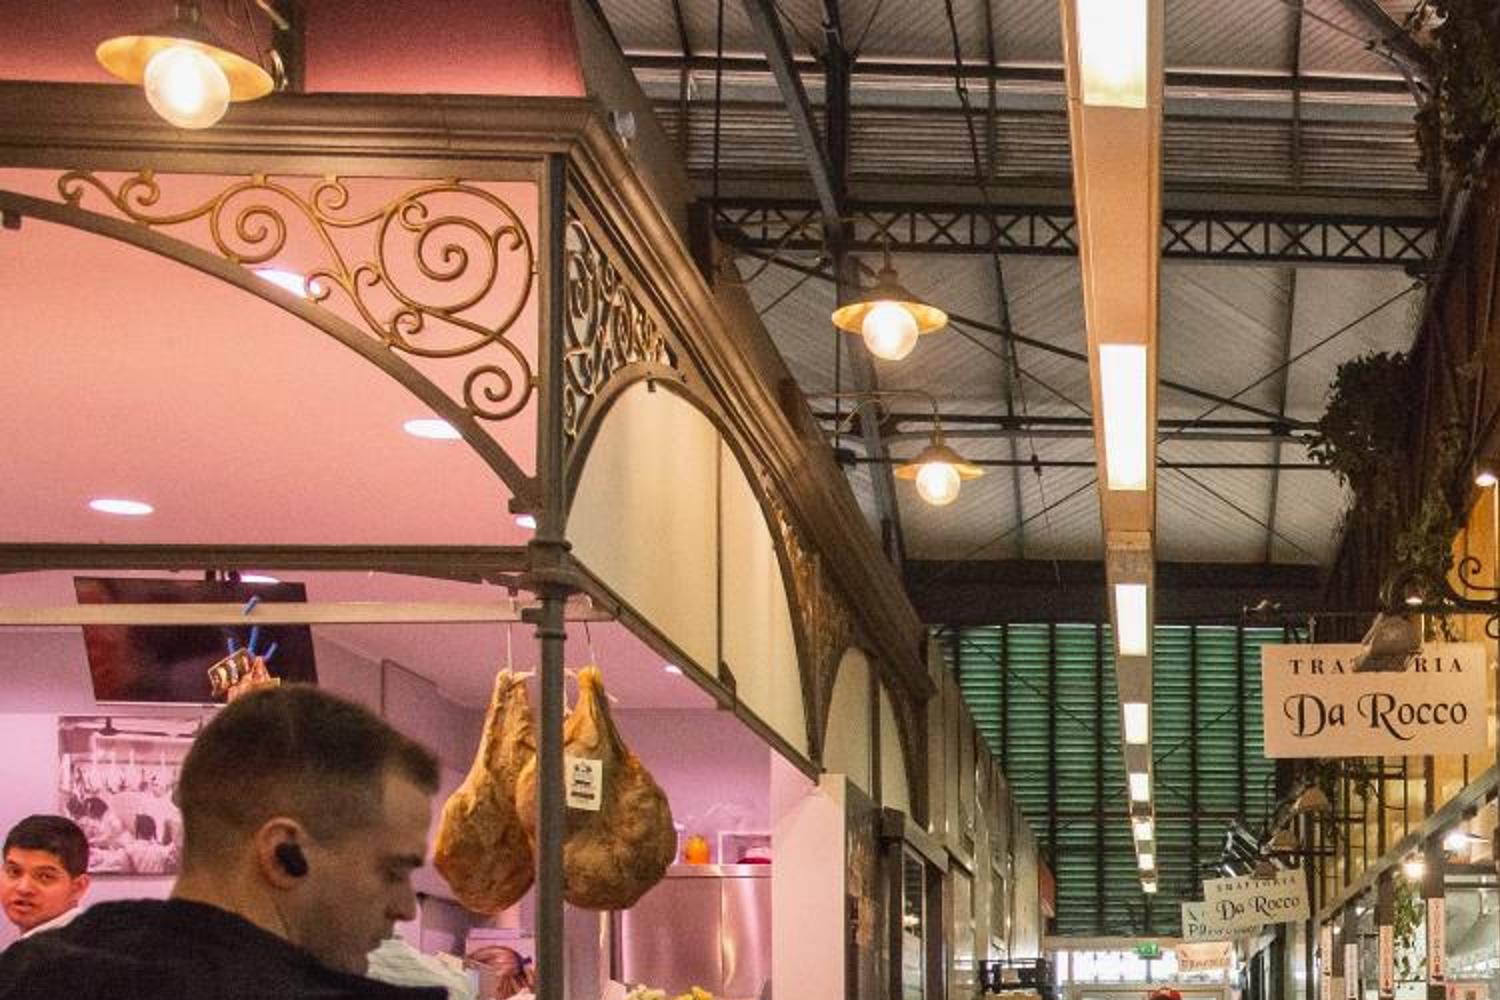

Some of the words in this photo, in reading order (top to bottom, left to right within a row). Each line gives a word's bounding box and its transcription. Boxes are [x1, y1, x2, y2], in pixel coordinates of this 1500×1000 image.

[1289, 657, 1463, 675] TRARIA
[1283, 693, 1345, 738] Da
[1356, 692, 1467, 741] Rocco
[1216, 900, 1245, 921] Da
[1247, 896, 1300, 919] Rocco
